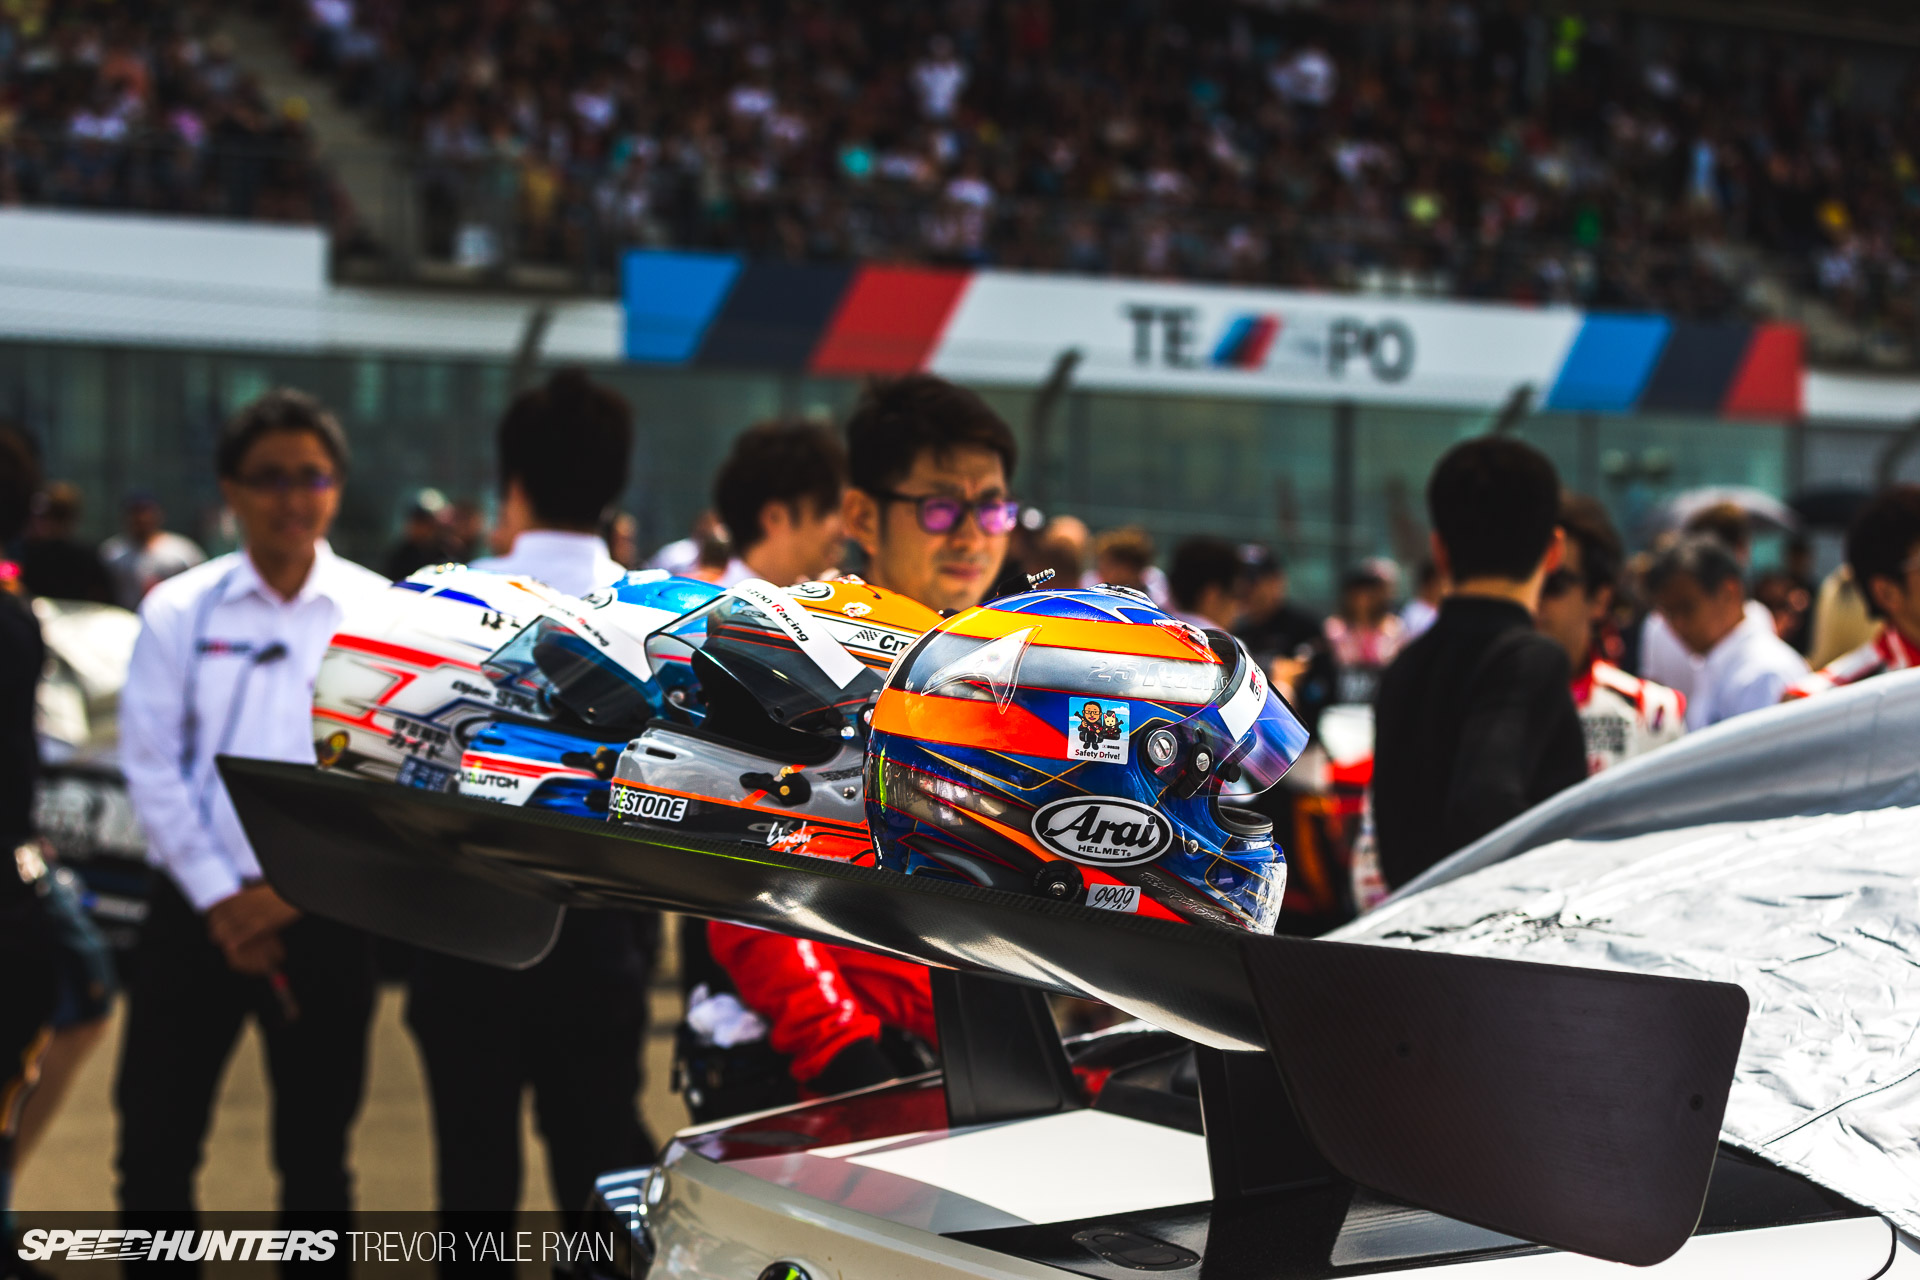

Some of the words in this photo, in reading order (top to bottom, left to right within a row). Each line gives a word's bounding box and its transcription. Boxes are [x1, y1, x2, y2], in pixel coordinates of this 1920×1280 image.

[771, 603, 810, 643] Racing
[1075, 749, 1098, 759] Safety
[1099, 751, 1120, 760] Drive!
[1043, 805, 1157, 849] Arai
[1077, 844, 1126, 857] HELMET
